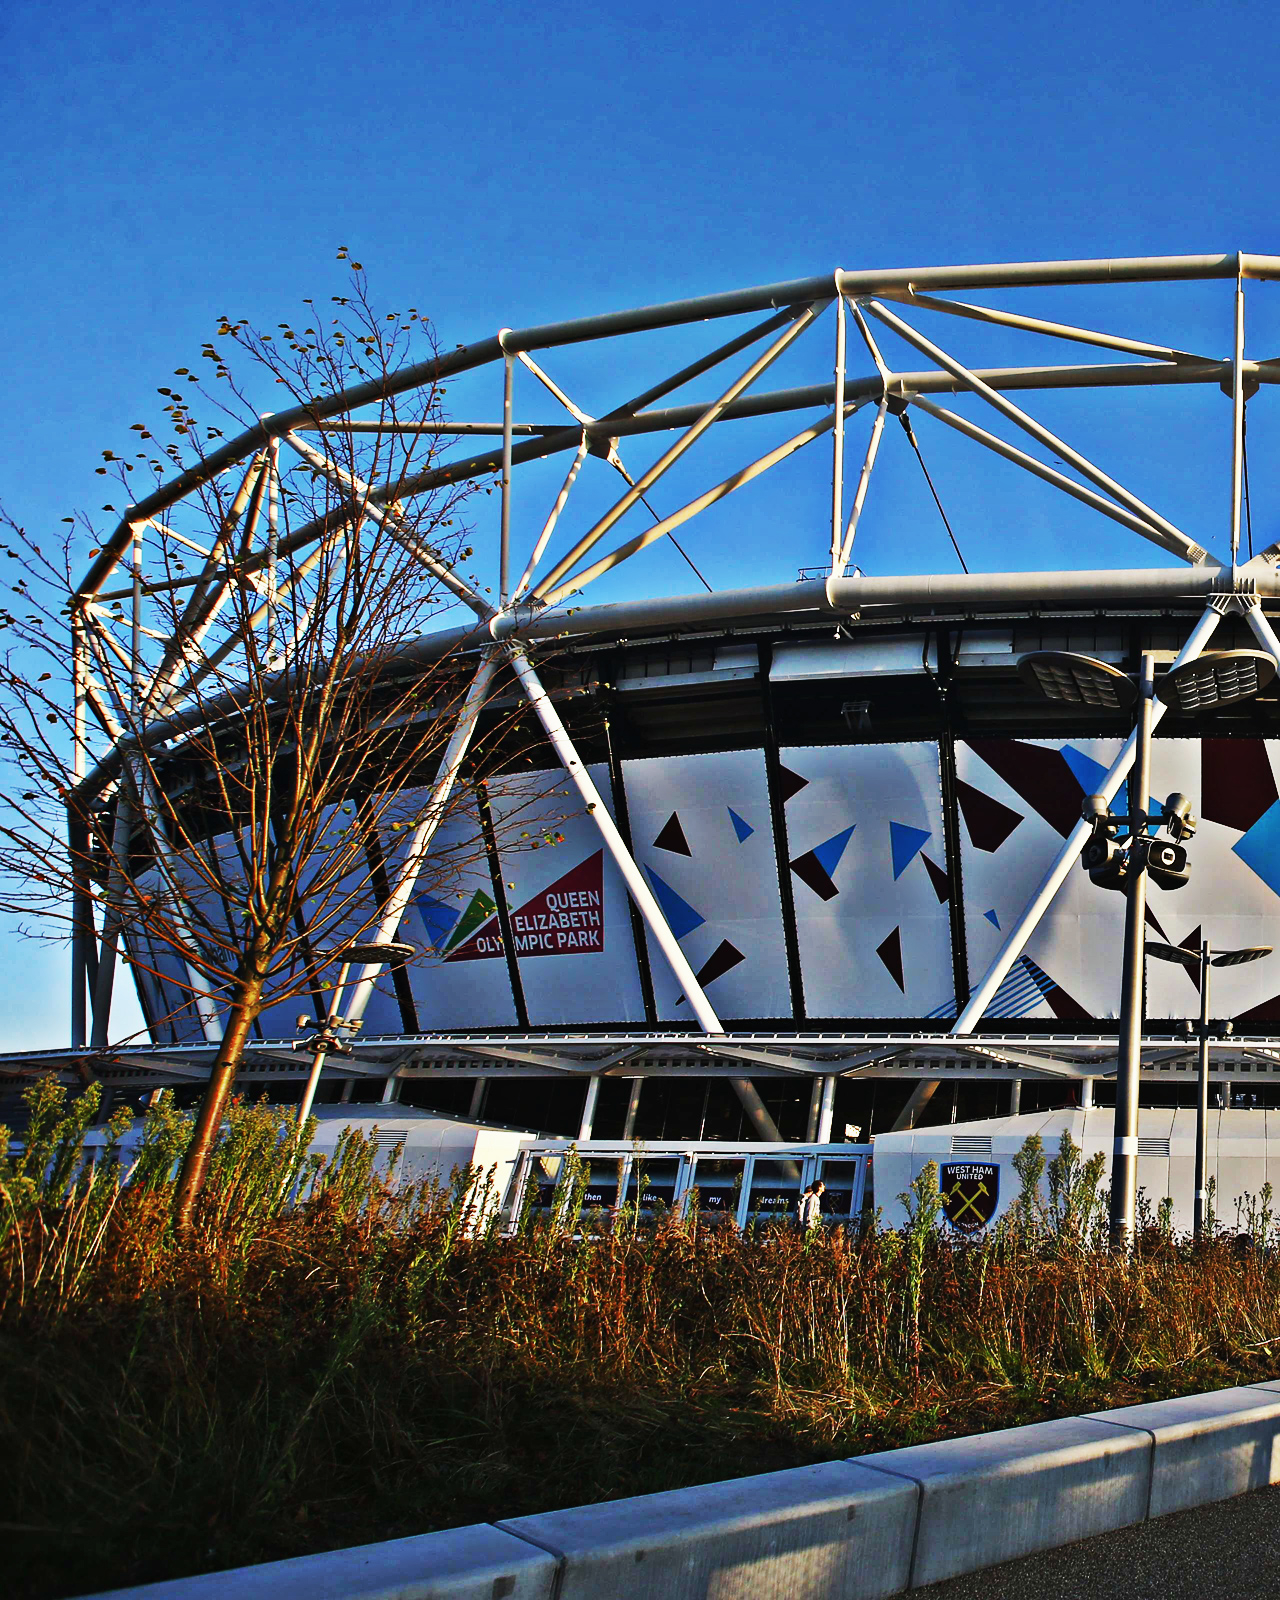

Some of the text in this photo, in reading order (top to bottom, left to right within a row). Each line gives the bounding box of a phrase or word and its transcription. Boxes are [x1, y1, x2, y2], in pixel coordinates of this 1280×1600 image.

[546, 890, 600, 912] QUEEN
[515, 911, 600, 932] ELIZABETH
[476, 930, 600, 953] OLYMPIC PARK
[947, 1166, 993, 1175] WEST HAM
[584, 1193, 602, 1201] then
[642, 1193, 657, 1202] like
[708, 1196, 721, 1205] my
